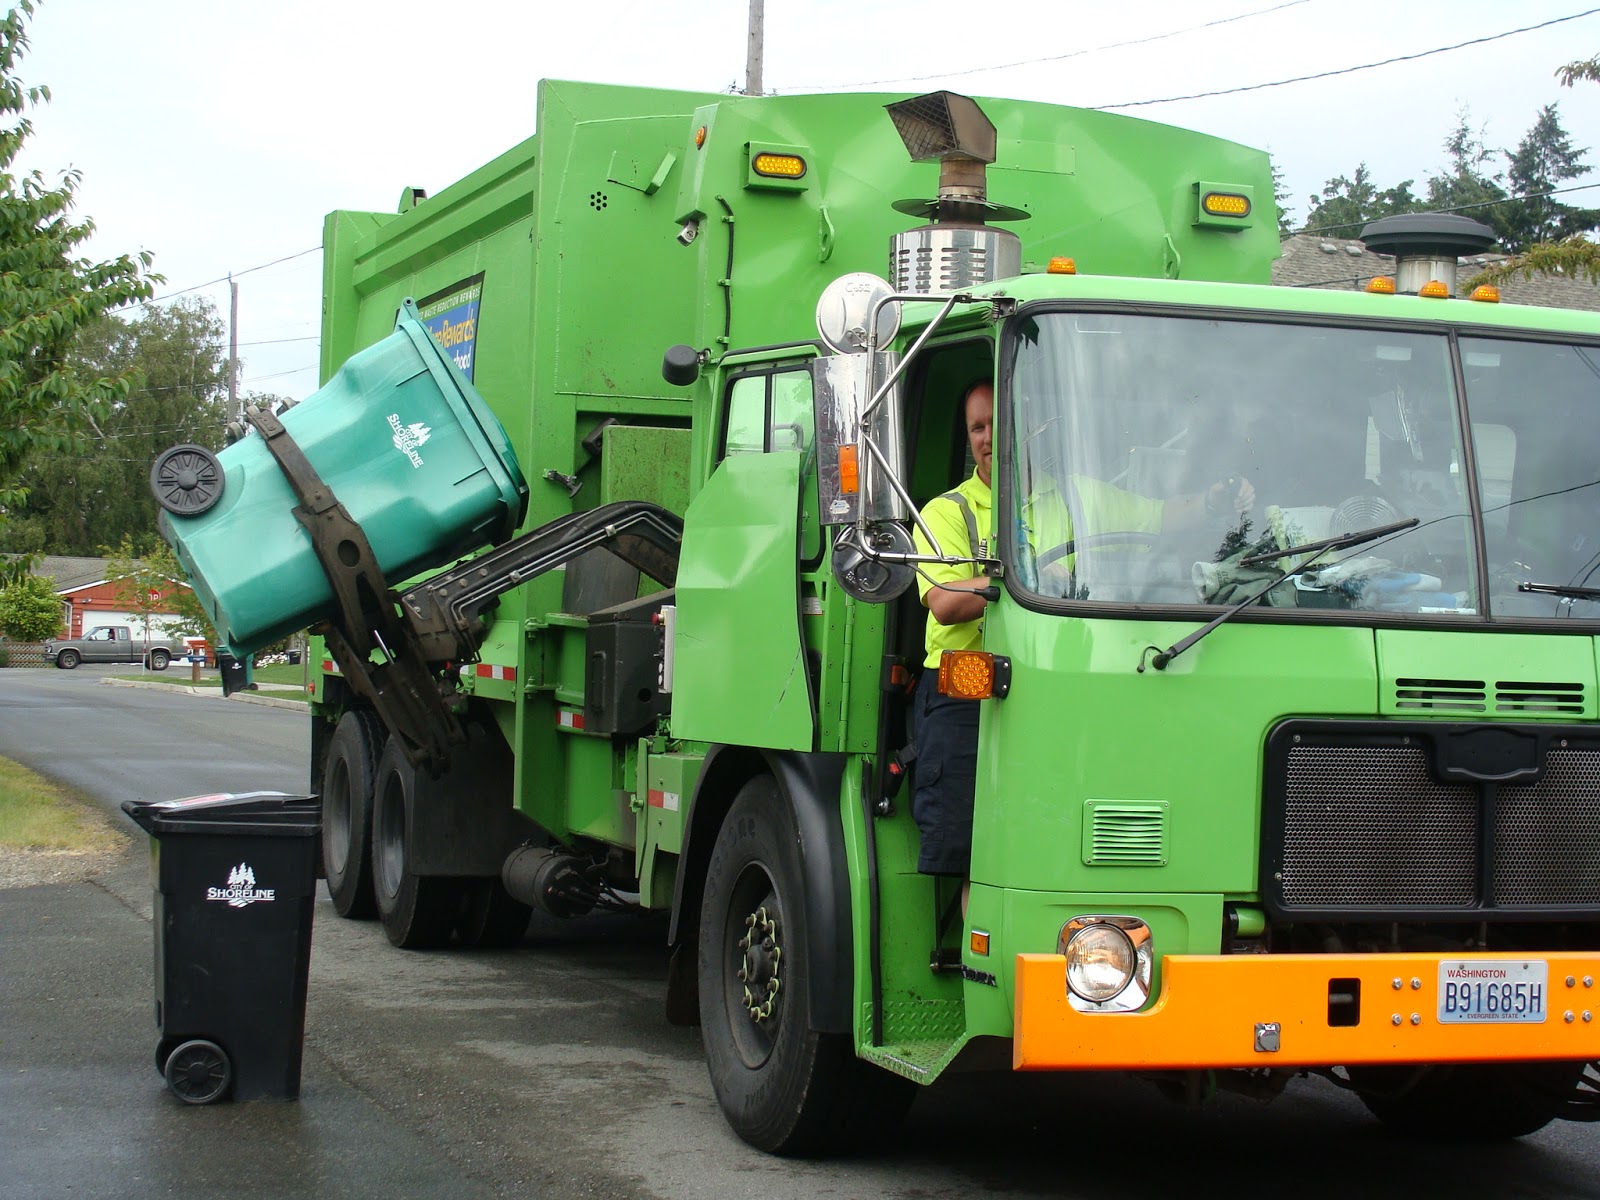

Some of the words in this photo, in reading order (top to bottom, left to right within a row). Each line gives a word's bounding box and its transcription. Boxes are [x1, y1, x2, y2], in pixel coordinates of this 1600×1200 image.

[436, 294, 460, 313] REDUCTION
[459, 286, 481, 303] REWARDS
[389, 413, 424, 468] SHORELINE
[207, 887, 275, 899] SHORELINE
[1447, 969, 1507, 978] WASHINGTON
[1445, 981, 1542, 1013] B91685H
